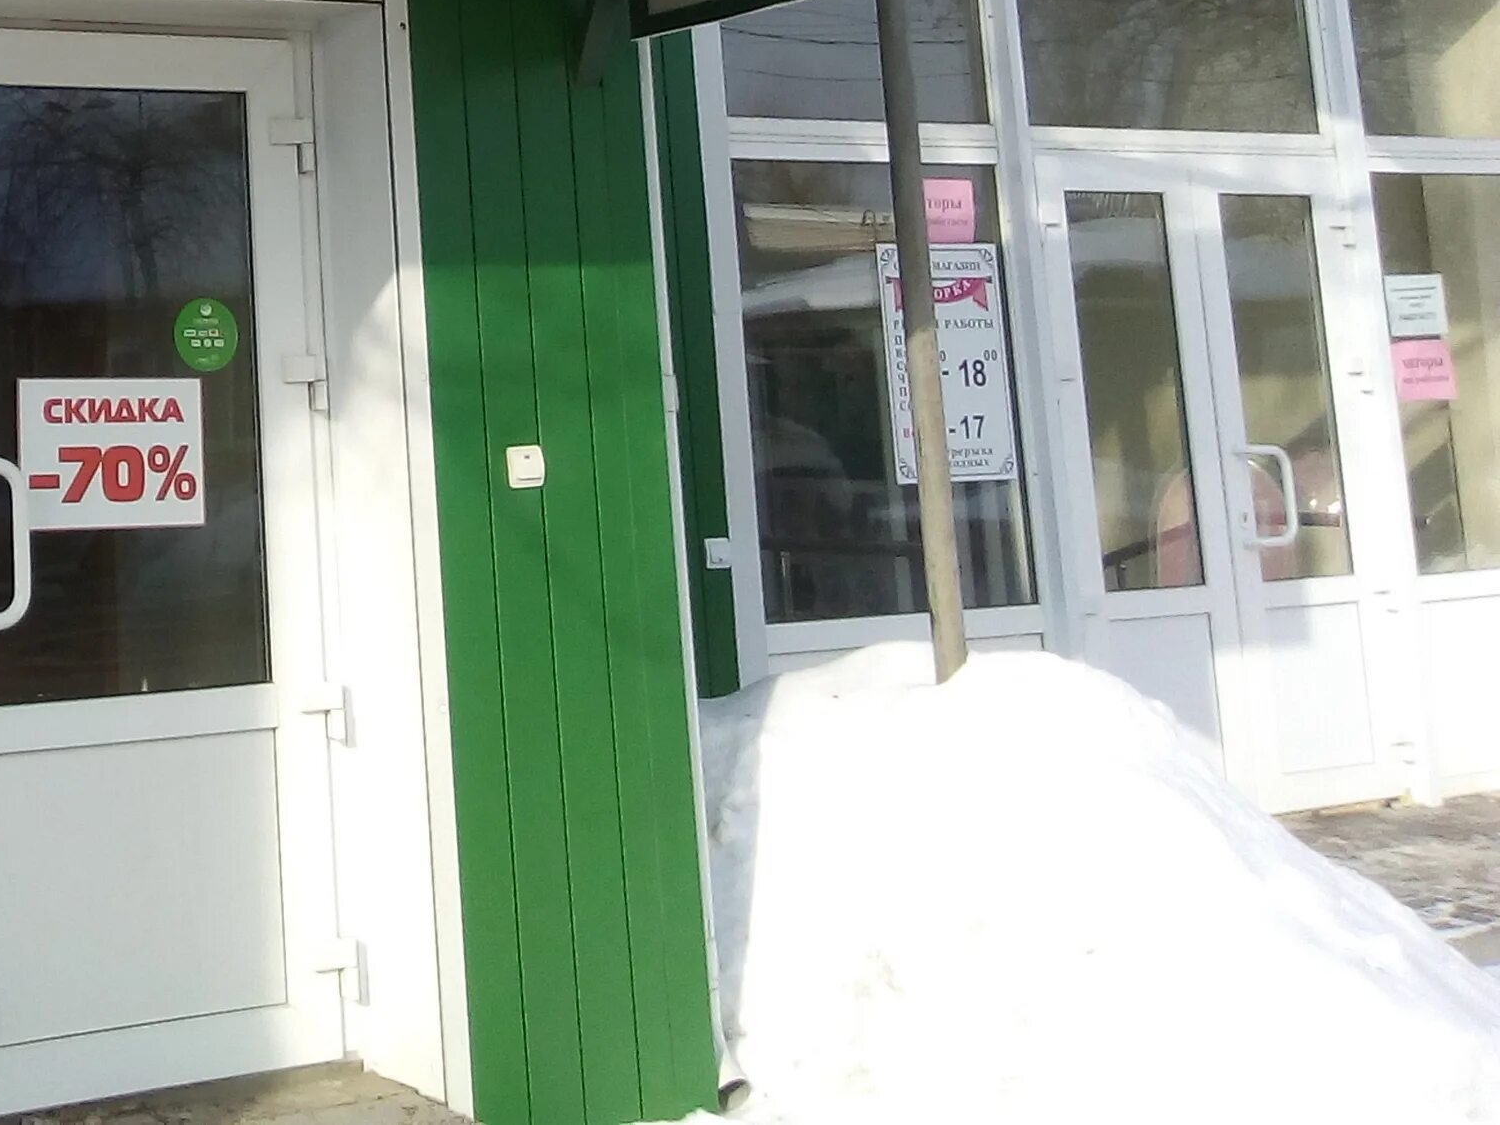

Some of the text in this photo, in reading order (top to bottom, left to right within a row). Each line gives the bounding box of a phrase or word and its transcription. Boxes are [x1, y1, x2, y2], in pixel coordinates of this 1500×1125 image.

[945, 319, 994, 329] РАБОТЫ
[958, 359, 987, 387] 18
[42, 397, 184, 425] СКИДКА
[29, 443, 198, 505] -70%
